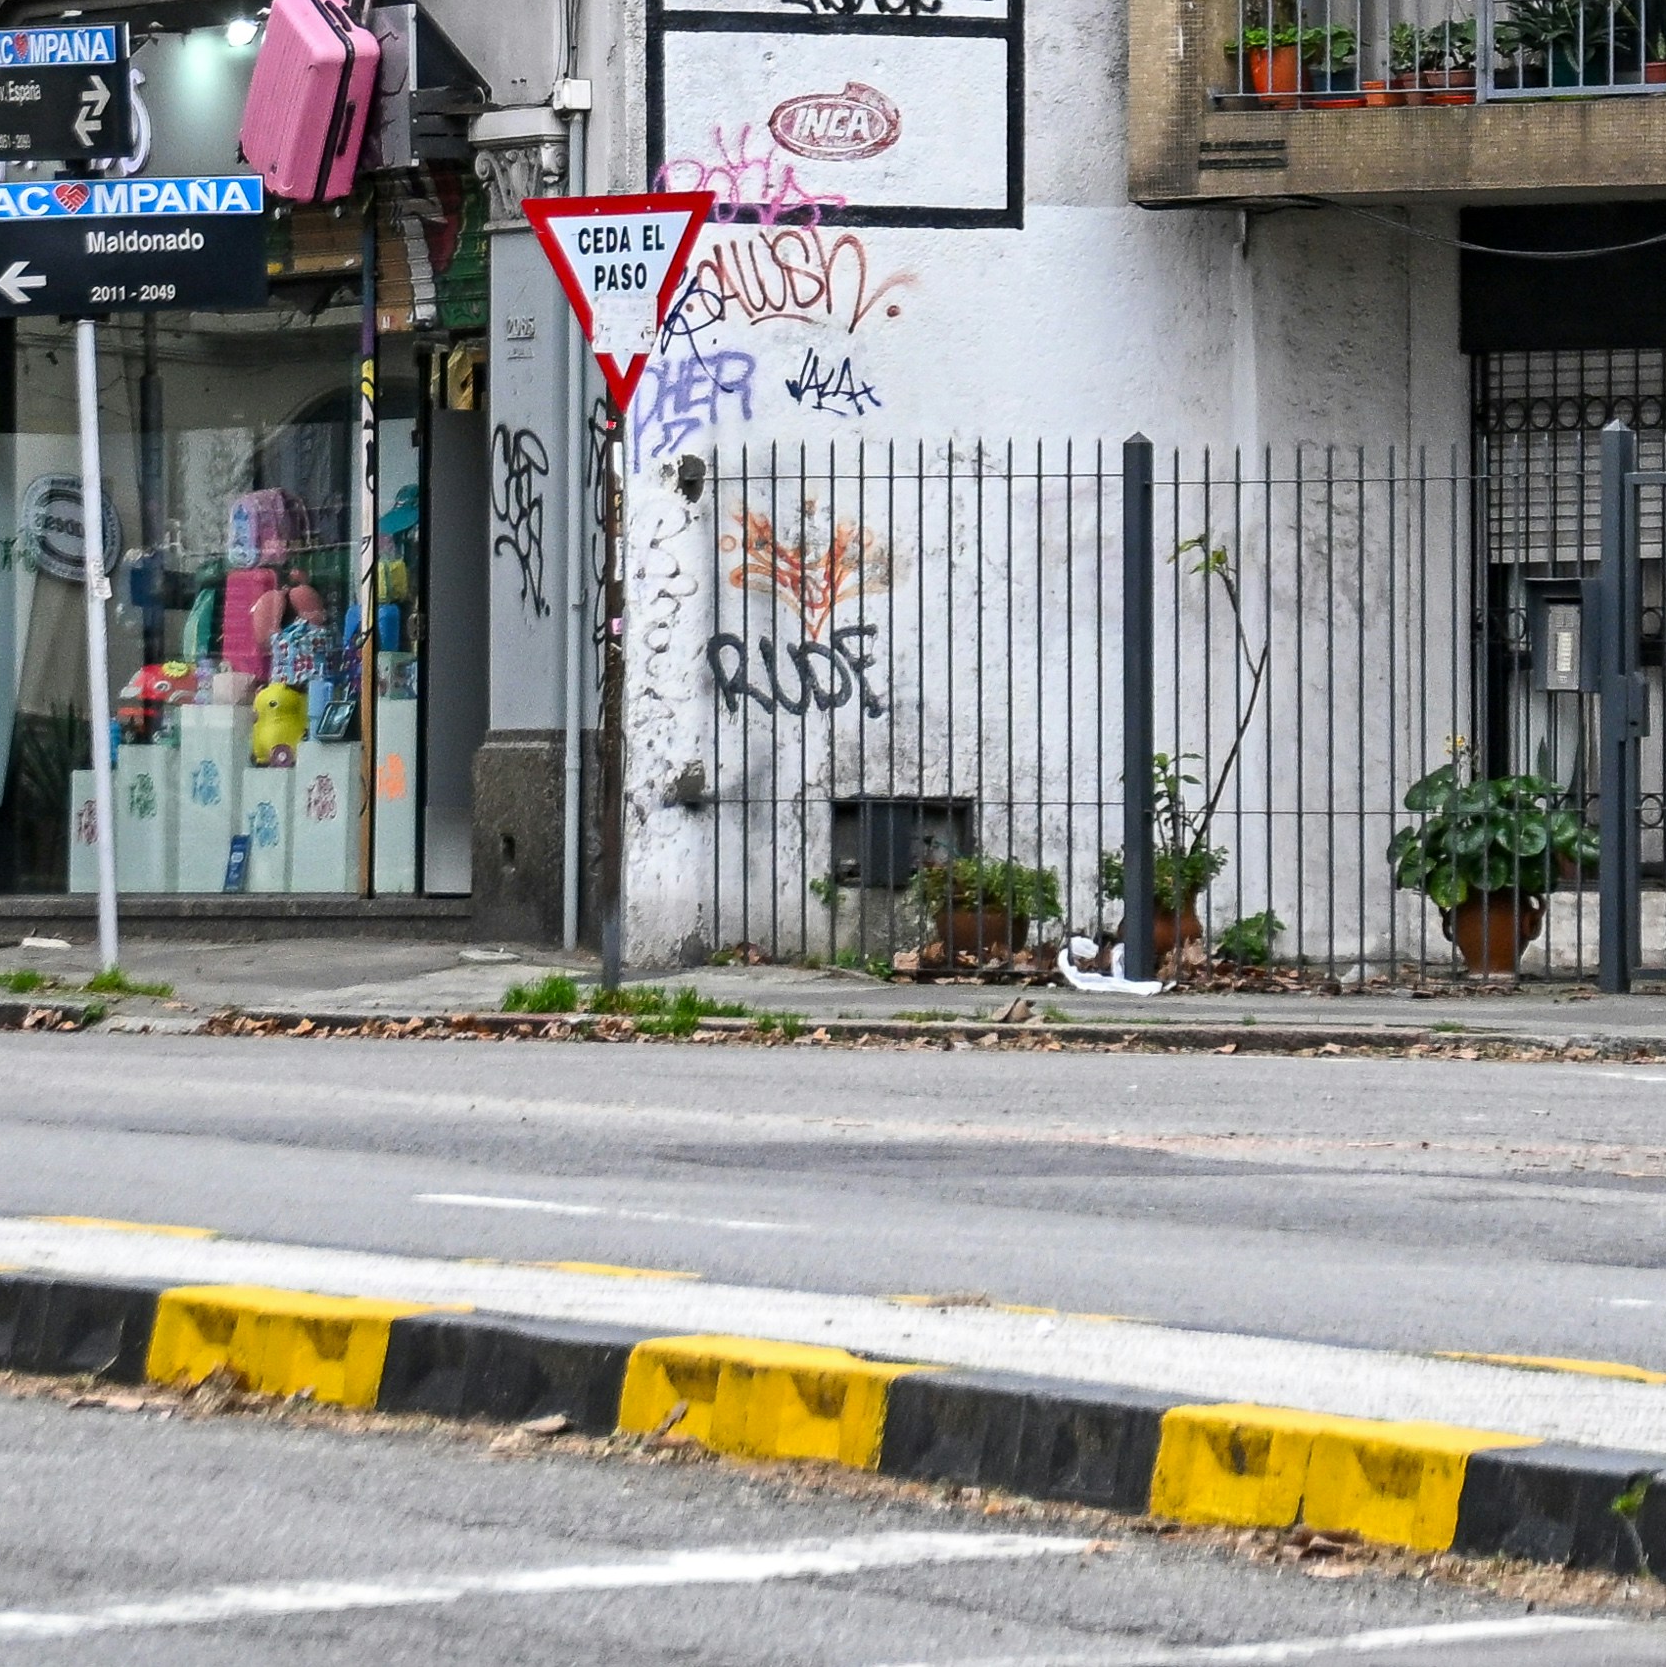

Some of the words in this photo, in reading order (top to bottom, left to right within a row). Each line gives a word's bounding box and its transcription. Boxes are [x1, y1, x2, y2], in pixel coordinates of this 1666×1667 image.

[792, 107, 870, 138] INCA
[86, 228, 205, 255] Maldonado
[578, 226, 632, 255] CEDA
[642, 224, 665, 251] EL
[594, 261, 647, 291] PASO
[91, 286, 127, 303] 2011
[140, 284, 177, 301] 2049
